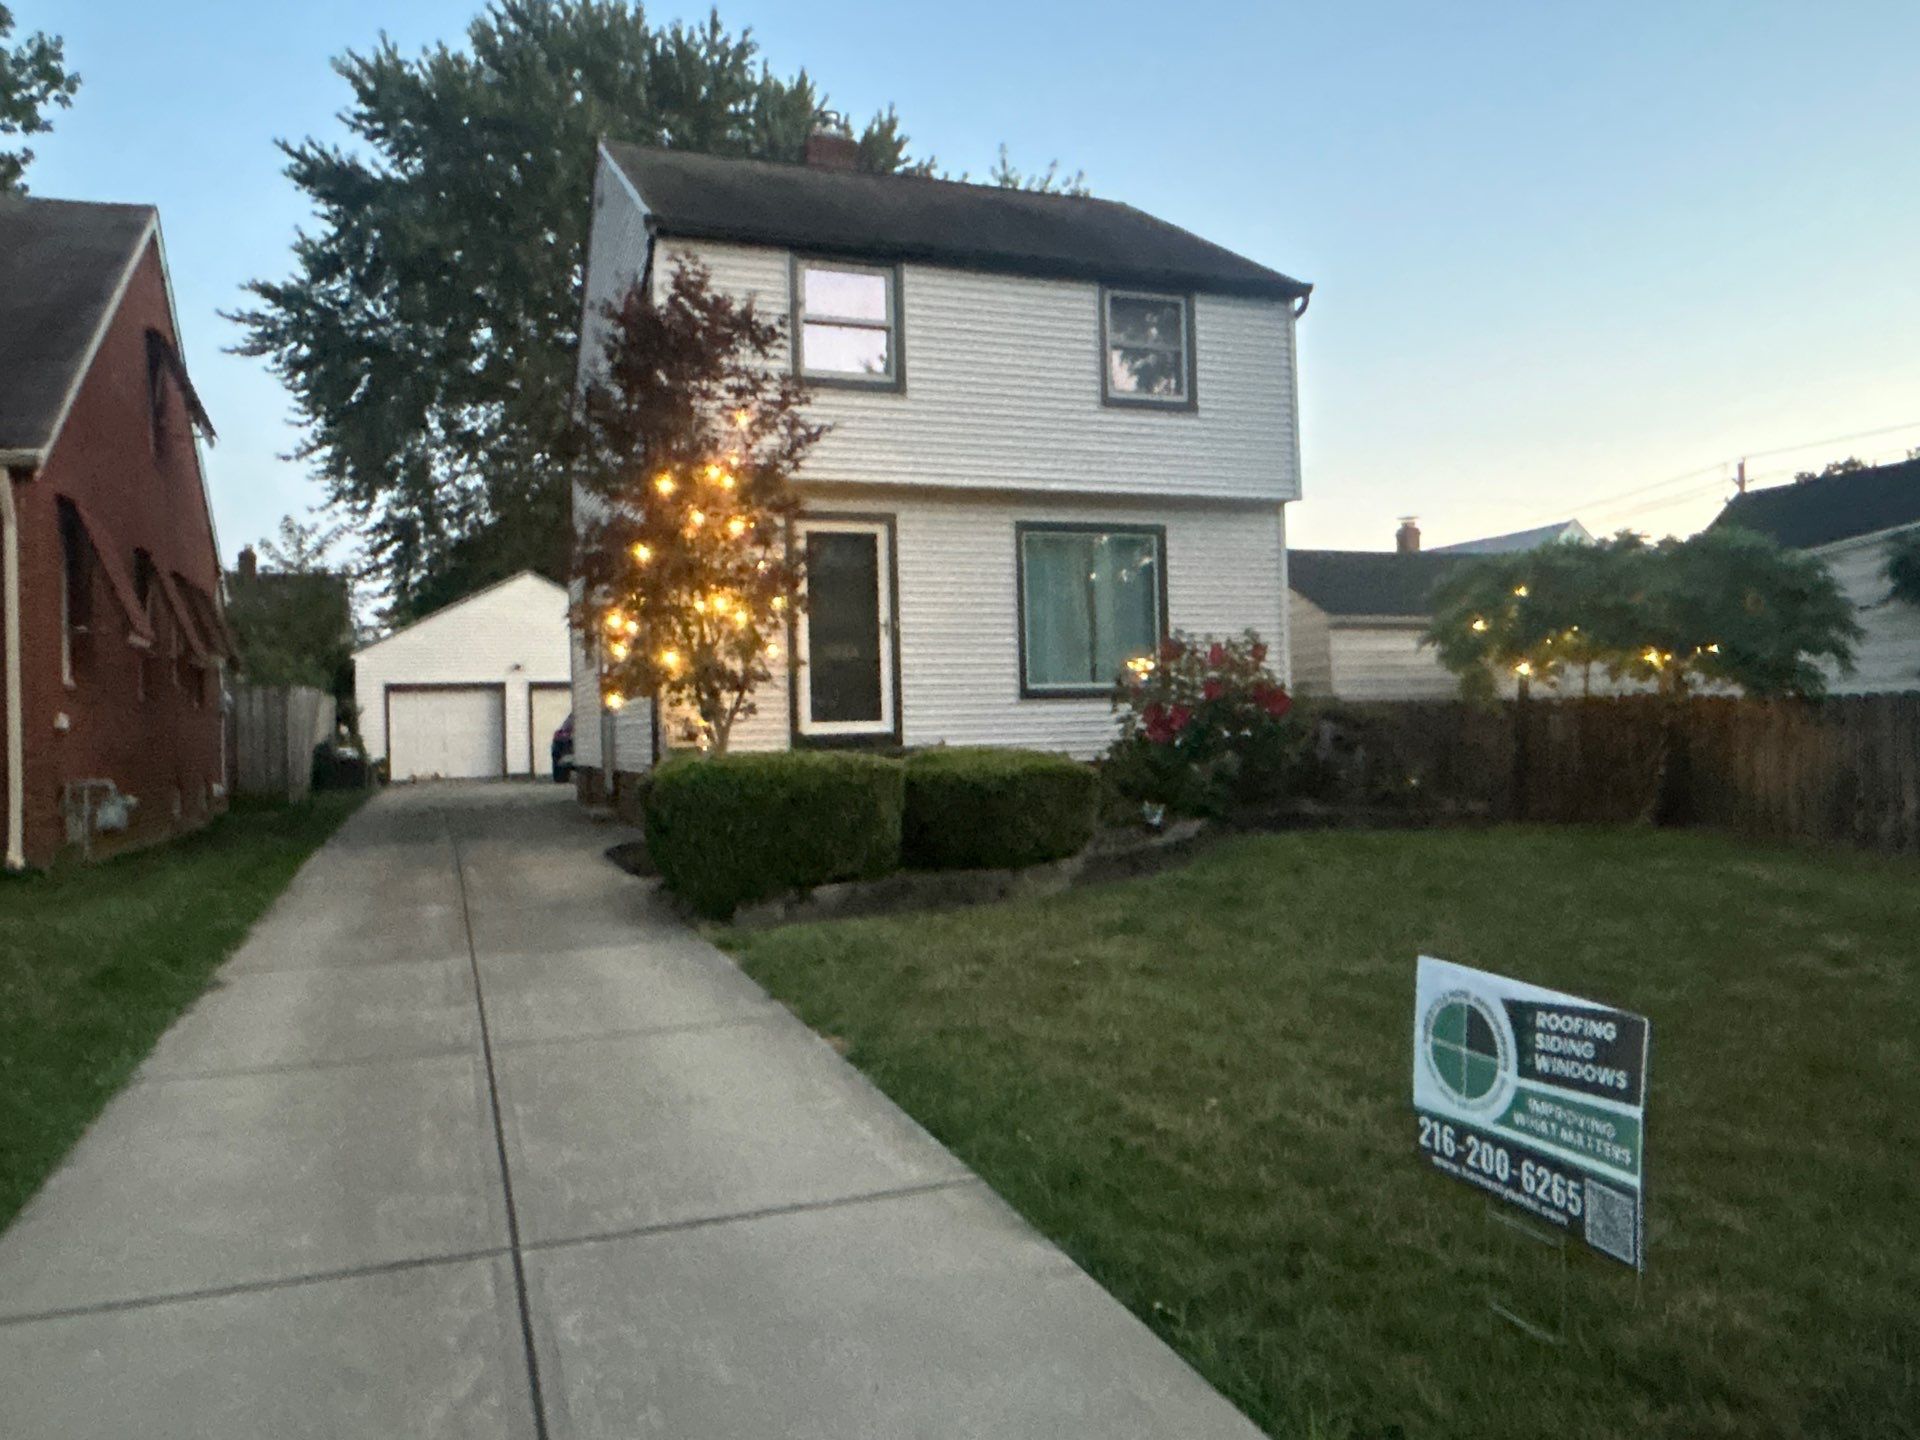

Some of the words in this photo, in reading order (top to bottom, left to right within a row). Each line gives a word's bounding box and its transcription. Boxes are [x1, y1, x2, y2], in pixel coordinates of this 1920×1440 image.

[1536, 1011, 1616, 1041] ROOFING
[1535, 1032, 1595, 1059] SIDING
[1535, 1053, 1628, 1090] WINDOWS
[1418, 1116, 1583, 1217] 216-200-6265
